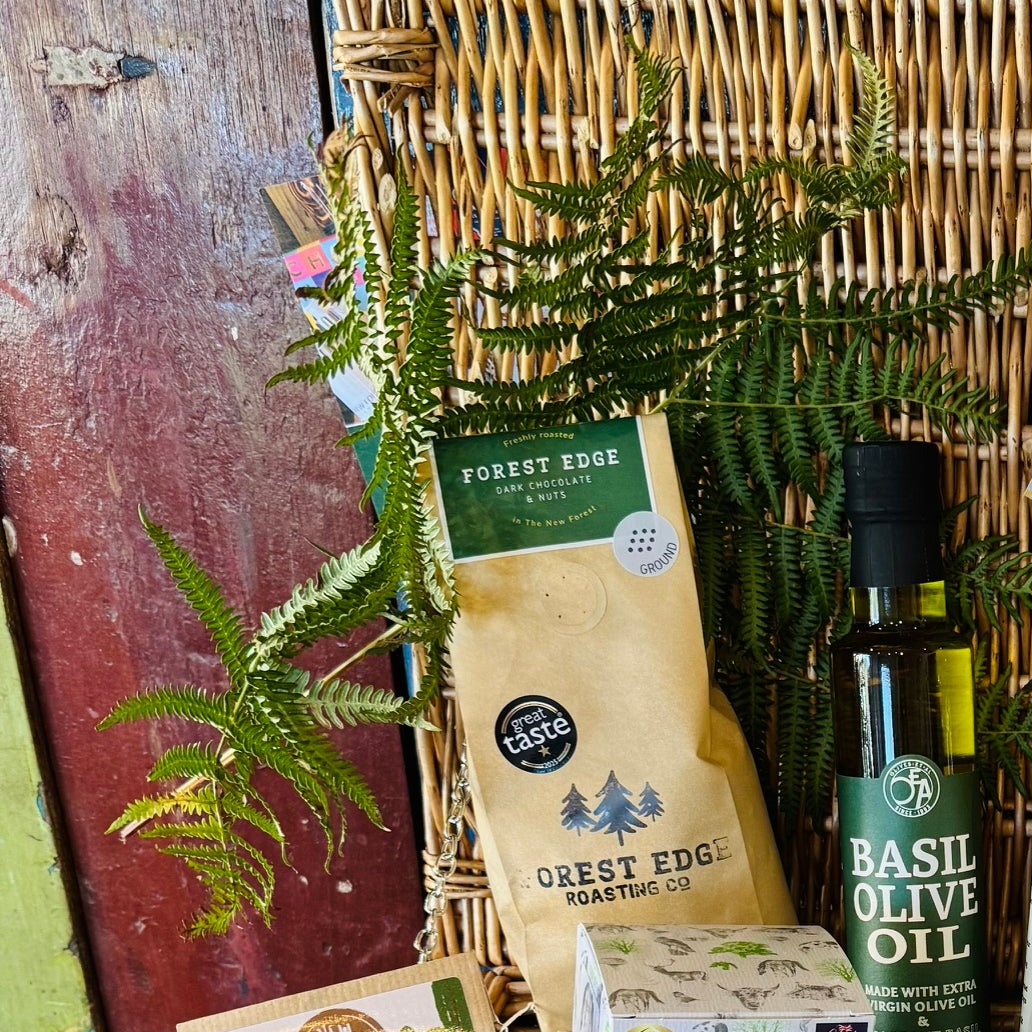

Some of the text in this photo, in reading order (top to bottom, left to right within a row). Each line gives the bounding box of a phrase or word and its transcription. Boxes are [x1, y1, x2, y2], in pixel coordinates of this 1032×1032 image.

[461, 448, 620, 484] FOREST EDGE
[496, 475, 593, 495] DARK CHOCOLATE
[640, 542, 677, 574] GROUND
[502, 716, 572, 755] taste
[510, 707, 548, 733] great
[850, 833, 976, 879] BASIL
[566, 880, 660, 907] ROASTING
[853, 876, 979, 923] OLIVE
[867, 924, 970, 965] OIL
[865, 979, 977, 998] MADE WITH EXTRA
[870, 994, 977, 1013] VIRGIN OLIVE OIL
